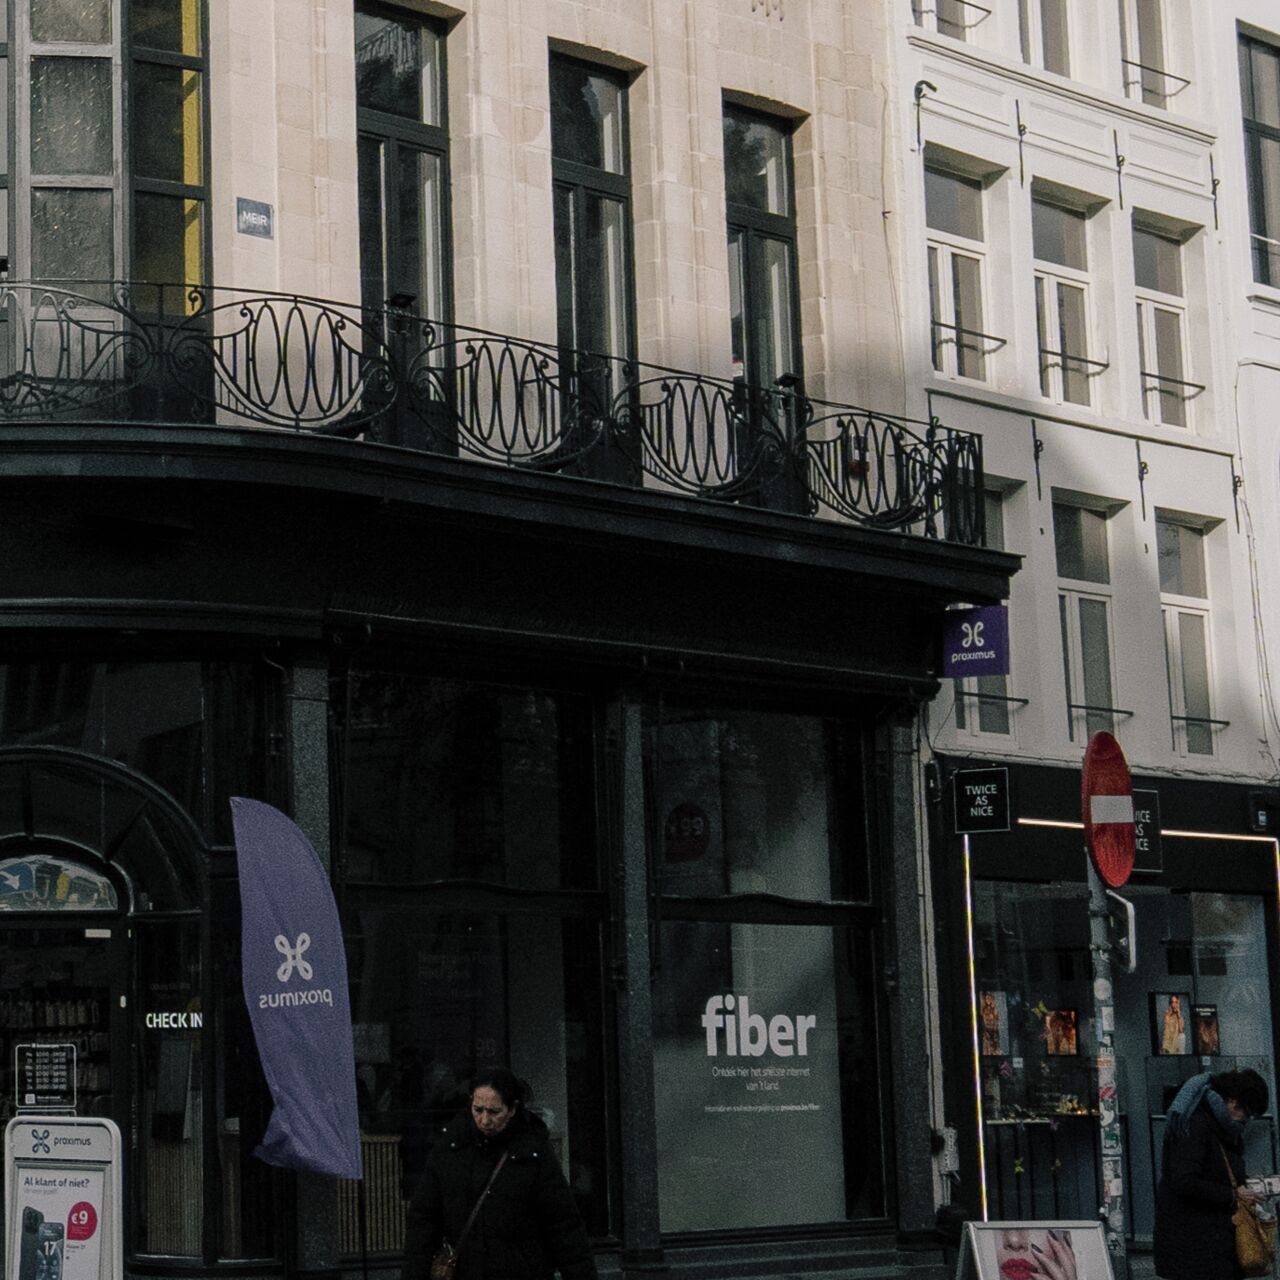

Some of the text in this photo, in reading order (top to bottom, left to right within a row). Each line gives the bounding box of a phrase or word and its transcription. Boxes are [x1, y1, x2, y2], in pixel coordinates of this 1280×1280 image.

[242, 210, 269, 227] MEIR
[951, 650, 996, 664] proximus
[965, 784, 997, 796] TWICE
[975, 795, 988, 806] AS
[970, 806, 994, 817] NICE
[1135, 810, 1151, 823] ICE
[1136, 838, 1149, 851] ICE
[145, 1011, 203, 1028] CHECK IN
[701, 994, 817, 1057] fiber
[53, 1136, 92, 1146] proximus
[23, 1176, 90, 1188] Al klant of niet?
[71, 1210, 88, 1225] €9
[43, 1241, 57, 1256] 17
